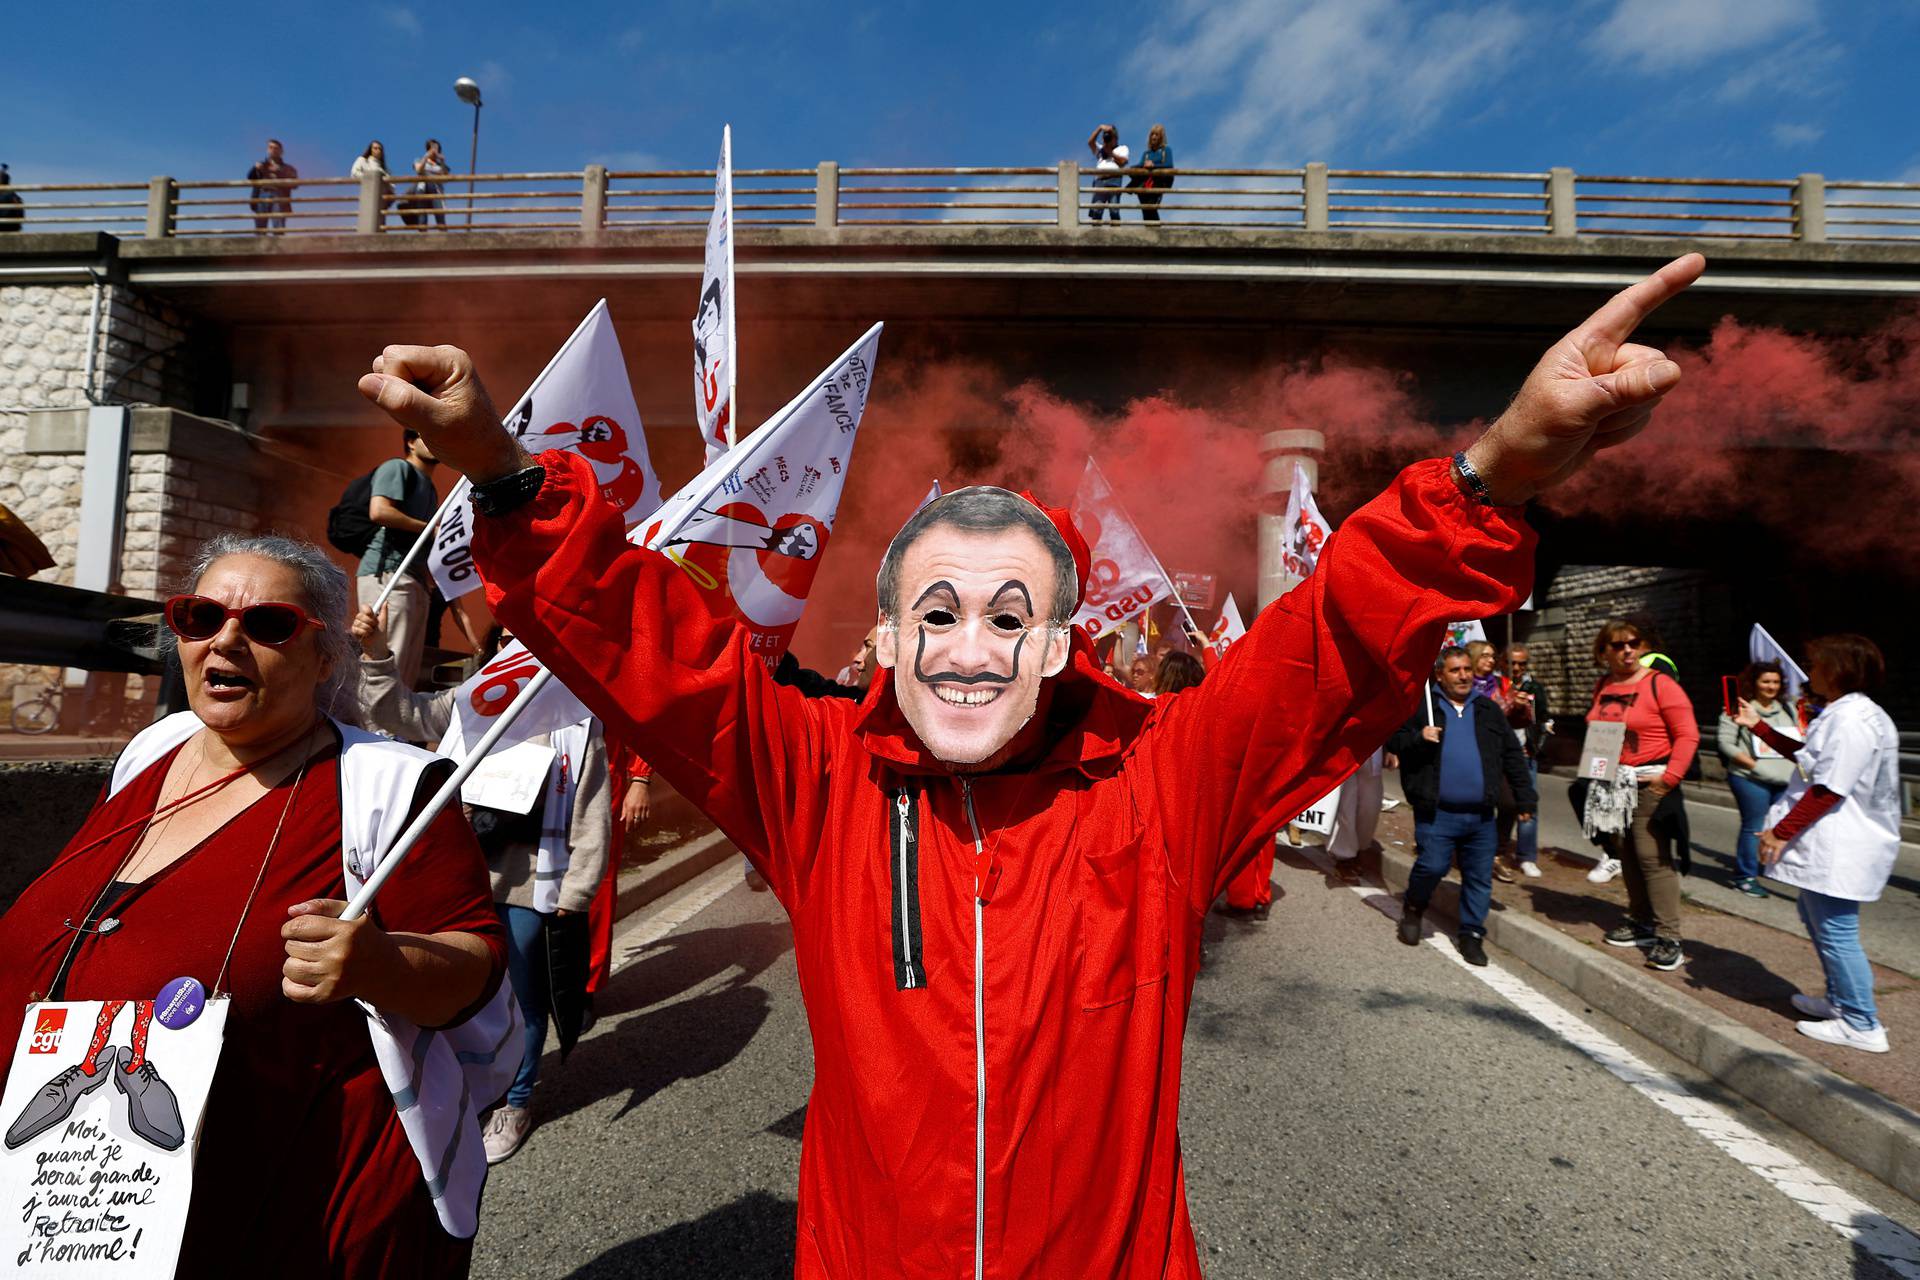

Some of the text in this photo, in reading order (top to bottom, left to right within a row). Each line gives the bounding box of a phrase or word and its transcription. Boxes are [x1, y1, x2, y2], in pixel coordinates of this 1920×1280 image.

[1295, 809, 1326, 826] ENT
[33, 1028, 63, 1053] cgt
[61, 1118, 107, 1143] Moi,
[36, 1138, 123, 1176] quand je
[31, 1161, 160, 1197] serai grande,
[22, 1188, 156, 1223] j'aurai une
[29, 1207, 131, 1238] Retraite
